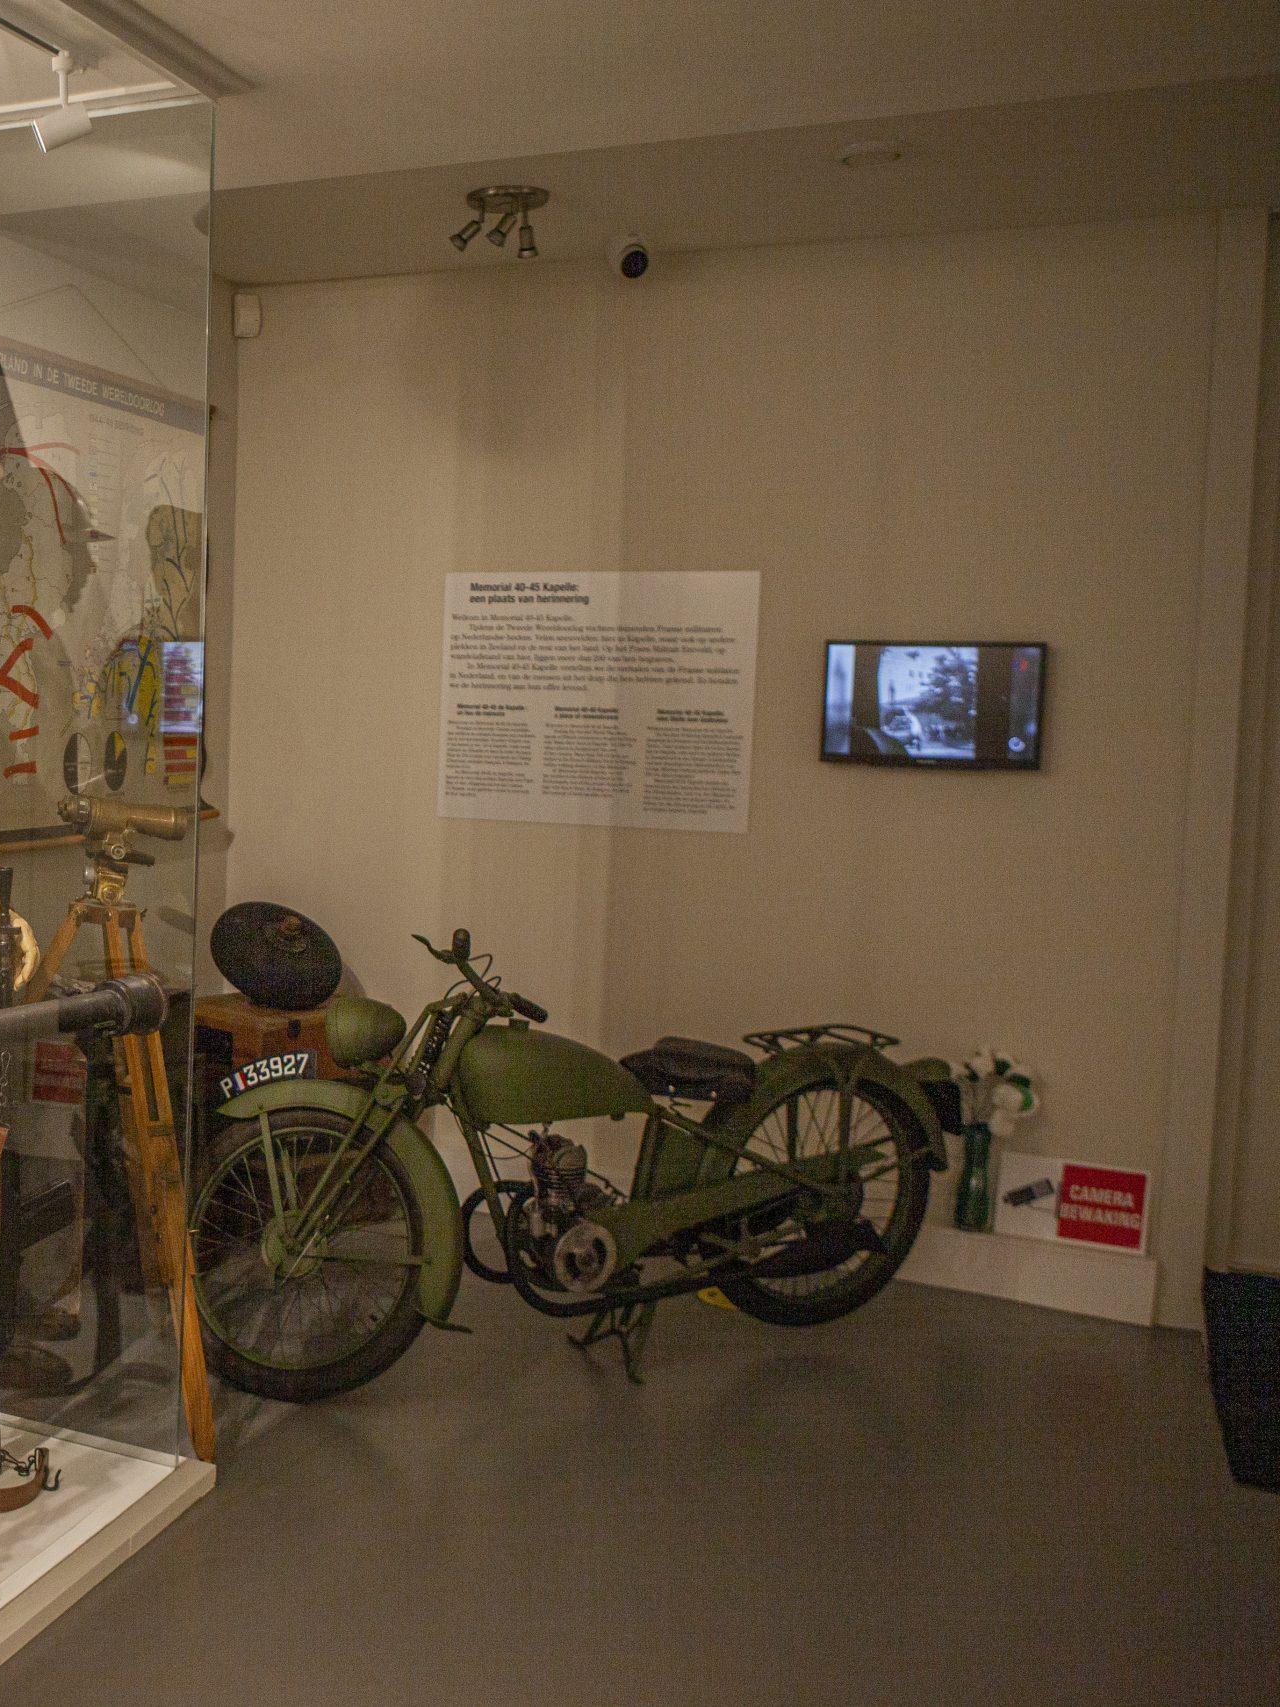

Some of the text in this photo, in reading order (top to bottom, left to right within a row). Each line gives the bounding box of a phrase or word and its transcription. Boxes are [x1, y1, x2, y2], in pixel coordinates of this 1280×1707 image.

[33, 363, 43, 379] IN
[47, 367, 59, 385] DE
[63, 372, 98, 396] TWEEDE
[102, 384, 165, 416] WERELDOORLOG
[470, 583, 512, 591] Memorial
[515, 583, 540, 591] 40-45
[488, 594, 515, 604] plaats
[537, 594, 589, 605] herinnering
[220, 1053, 309, 1099] P 33927
[1069, 1184, 1135, 1208] CAMERA
